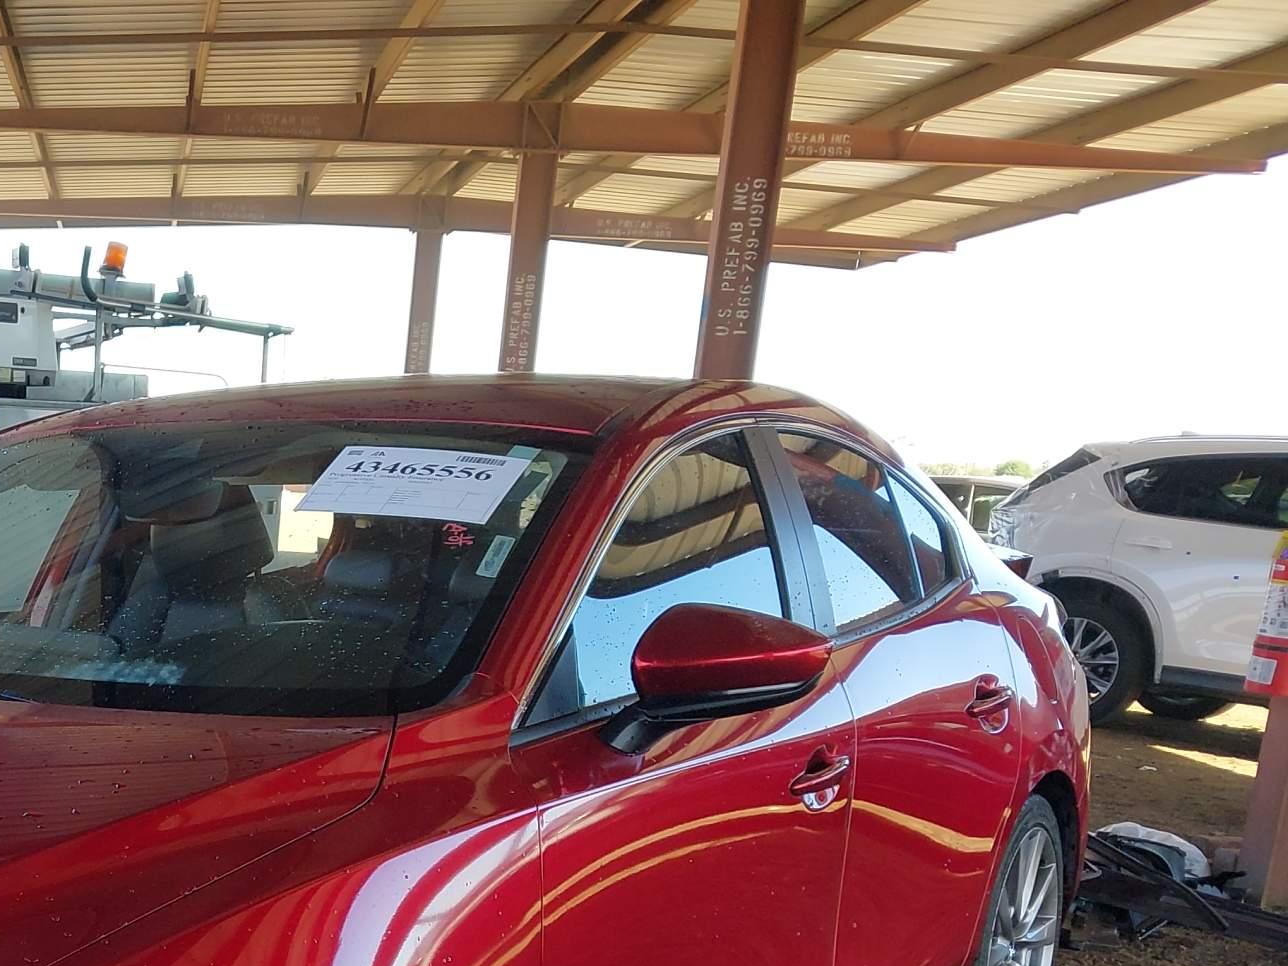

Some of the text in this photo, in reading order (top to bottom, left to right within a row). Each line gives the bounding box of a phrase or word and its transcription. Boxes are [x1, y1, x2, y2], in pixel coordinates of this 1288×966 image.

[715, 176, 751, 337] U.S. PREFAB INC.
[733, 178, 768, 335] 1-866-799-0969
[345, 461, 496, 481] 43465556
